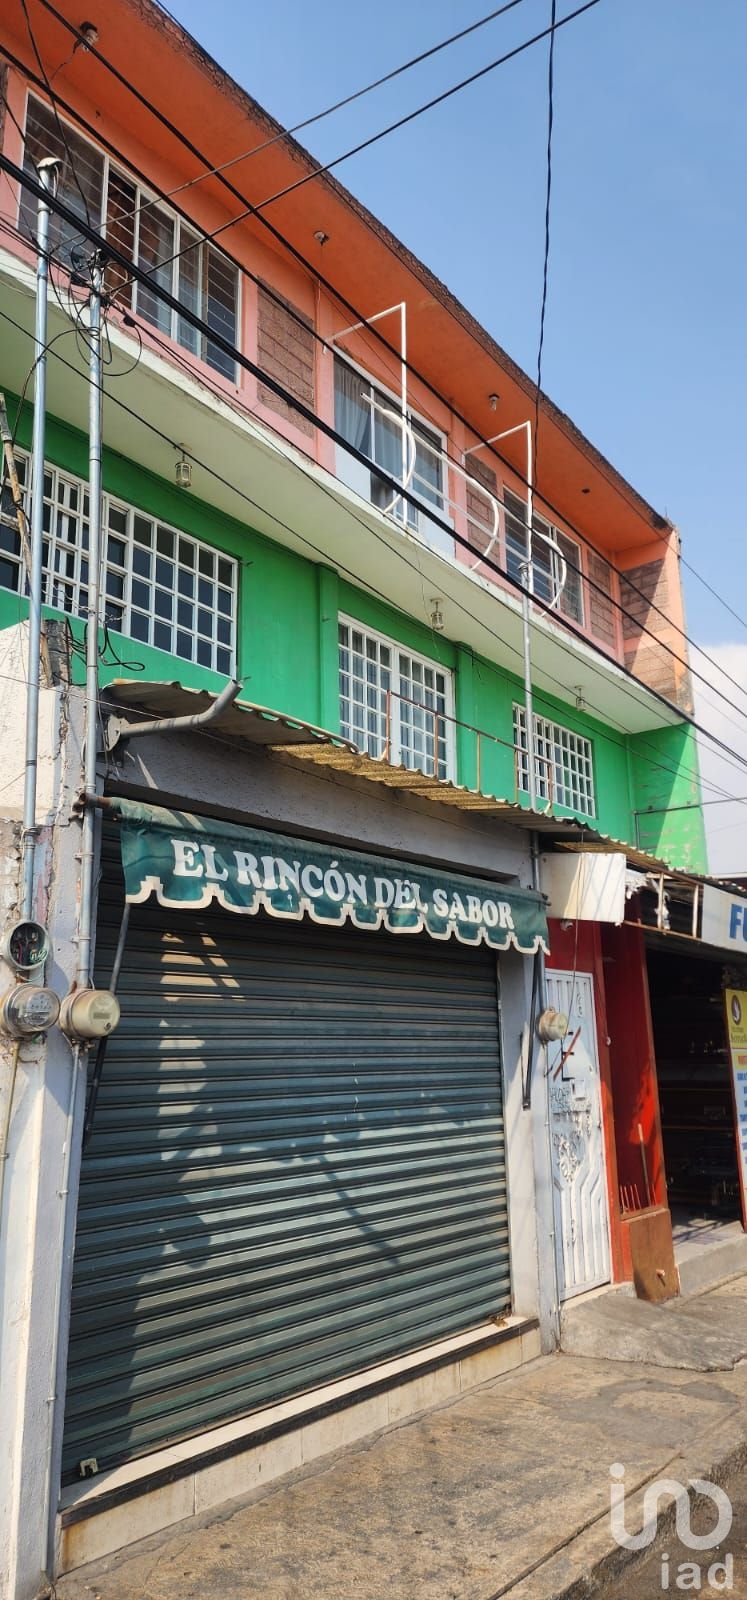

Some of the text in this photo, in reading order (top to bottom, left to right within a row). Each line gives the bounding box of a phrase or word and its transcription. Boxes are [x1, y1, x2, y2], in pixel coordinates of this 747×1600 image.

[171, 839, 515, 930] EL RINCÓN DEL SABOR
